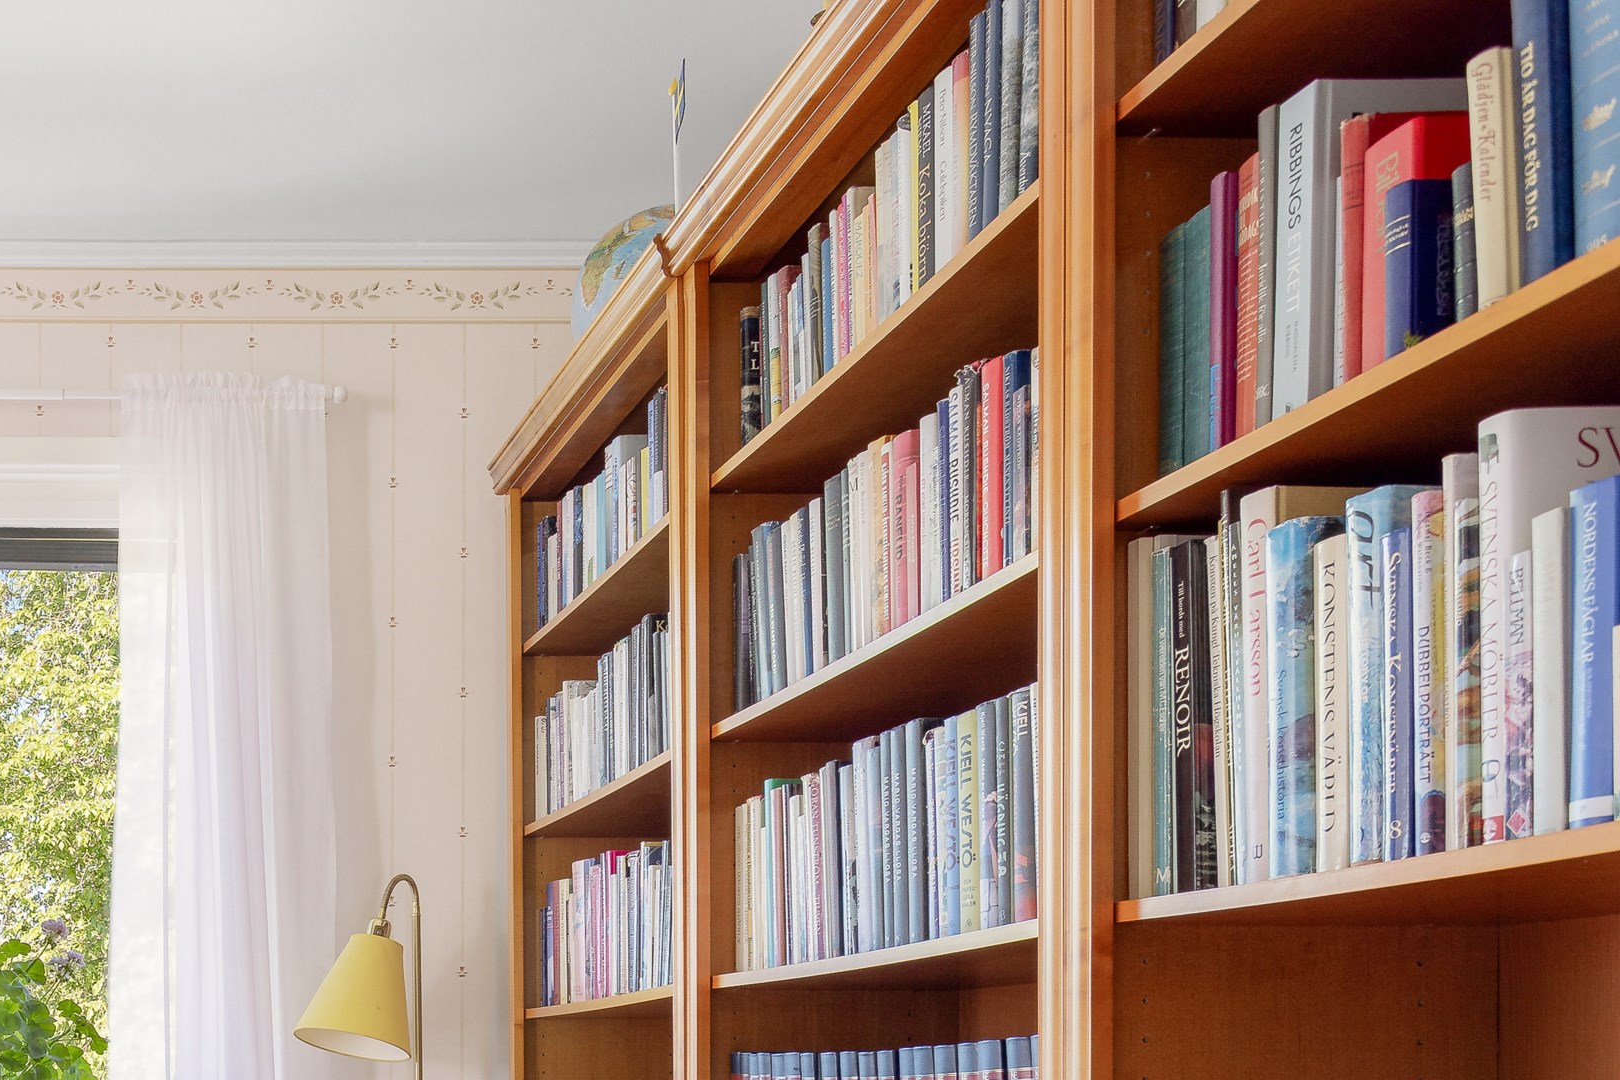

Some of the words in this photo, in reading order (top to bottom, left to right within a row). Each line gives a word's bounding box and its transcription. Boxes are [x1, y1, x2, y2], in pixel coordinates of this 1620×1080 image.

[1520, 41, 1534, 79] TIO
[1521, 80, 1538, 108] ÅR
[922, 103, 932, 158] MIKAEL
[983, 98, 992, 166] NYAGA
[1522, 107, 1537, 149] DAG
[919, 163, 931, 217] Koka
[970, 112, 979, 228] RYMDVÄKTAREN
[1287, 122, 1304, 230] RIBBINGS
[1524, 149, 1540, 188] FÖR
[1526, 190, 1538, 232] DAG
[918, 219, 932, 281] björn
[1286, 231, 1302, 315] ETIKETT
[949, 392, 960, 452] SALMAN
[982, 383, 990, 435] SALMAN
[950, 458, 961, 522] RUSHDIE
[982, 440, 990, 493] RUSHDIE
[895, 494, 904, 561] RANELID
[1247, 518, 1267, 579] Carl
[1480, 481, 1498, 611] SVENSKA
[1581, 501, 1598, 595] NORDENS
[1178, 596, 1186, 614] bords
[1209, 555, 1220, 600] Konsten
[1388, 552, 1402, 645] SVENSKA
[1208, 601, 1220, 615] på
[1509, 567, 1525, 647] BELLMAN
[1581, 596, 1600, 665] FÅGLAR
[1247, 591, 1267, 698] Larsson
[1324, 561, 1337, 723] KONSTENS
[1174, 644, 1192, 758] RENOIR
[1211, 654, 1222, 699] Tekniska
[1275, 668, 1288, 721] Svensk
[1417, 626, 1435, 784] DUBBELPORTRÄTT
[1481, 621, 1504, 743] MÖBLER
[1017, 701, 1029, 740] KJELL
[1211, 701, 1223, 758] Högskolan
[910, 768, 918, 799] MARIO
[944, 739, 956, 789] KJELL
[960, 734, 972, 790] KJELL
[1276, 726, 1289, 821] konsthistoria
[883, 776, 891, 807] MARIO
[910, 803, 918, 842] VARGAS
[946, 797, 960, 871] WESTÖ
[961, 793, 976, 868] WESTÖ
[1389, 820, 1402, 840] 8
